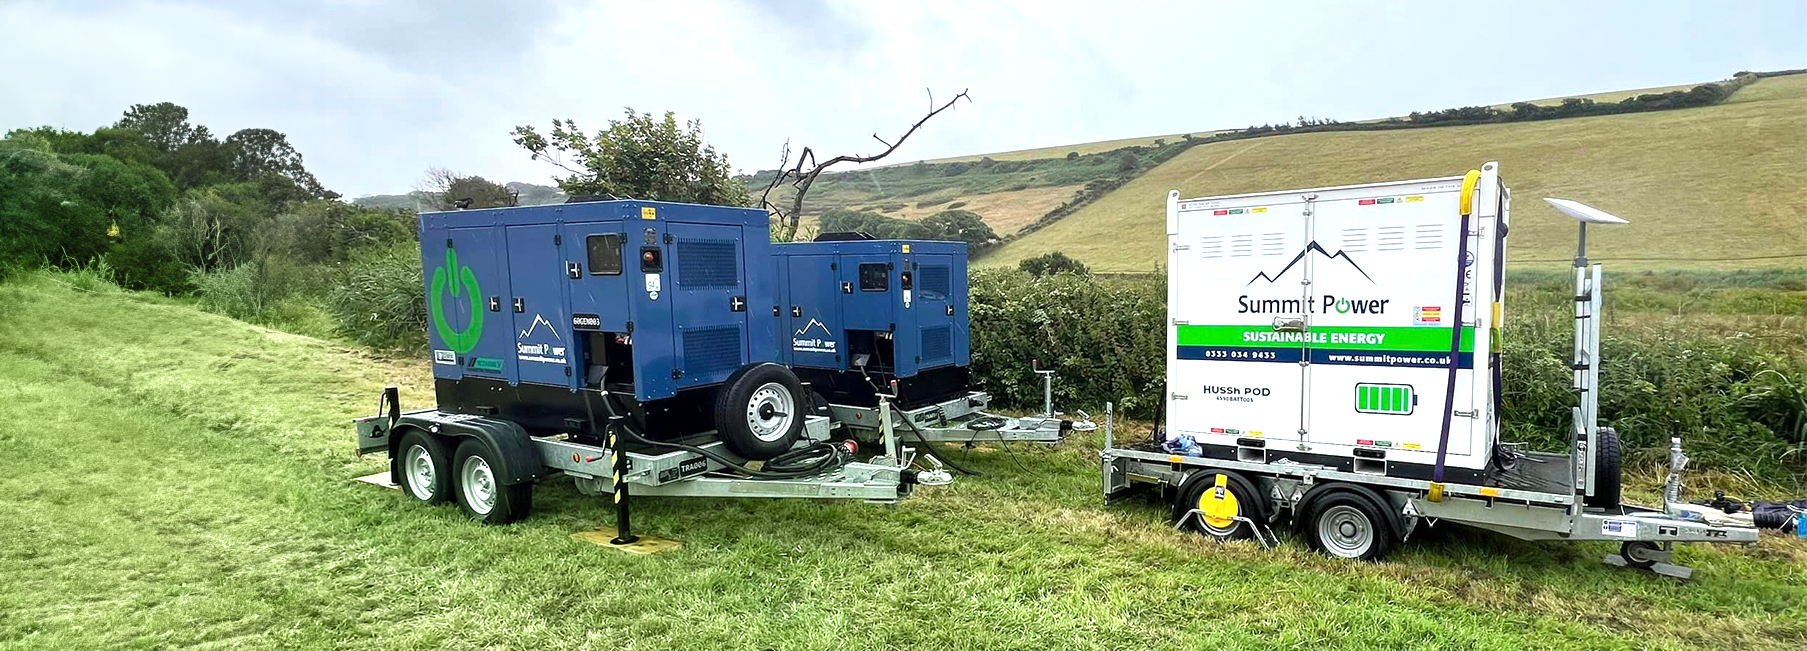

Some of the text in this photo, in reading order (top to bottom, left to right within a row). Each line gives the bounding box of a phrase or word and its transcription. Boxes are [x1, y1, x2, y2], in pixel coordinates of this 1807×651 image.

[1238, 295, 1315, 314] Summit
[792, 337, 836, 348] Summit Pwer
[1243, 332, 1385, 344] SUSTAINABLE ENERGY
[517, 342, 566, 356] Summit Pwer
[1205, 350, 1227, 358] 0333
[1252, 351, 1276, 359] 9433
[1328, 354, 1451, 365] www.summitpower.co.uk
[1244, 387, 1271, 397] POD
